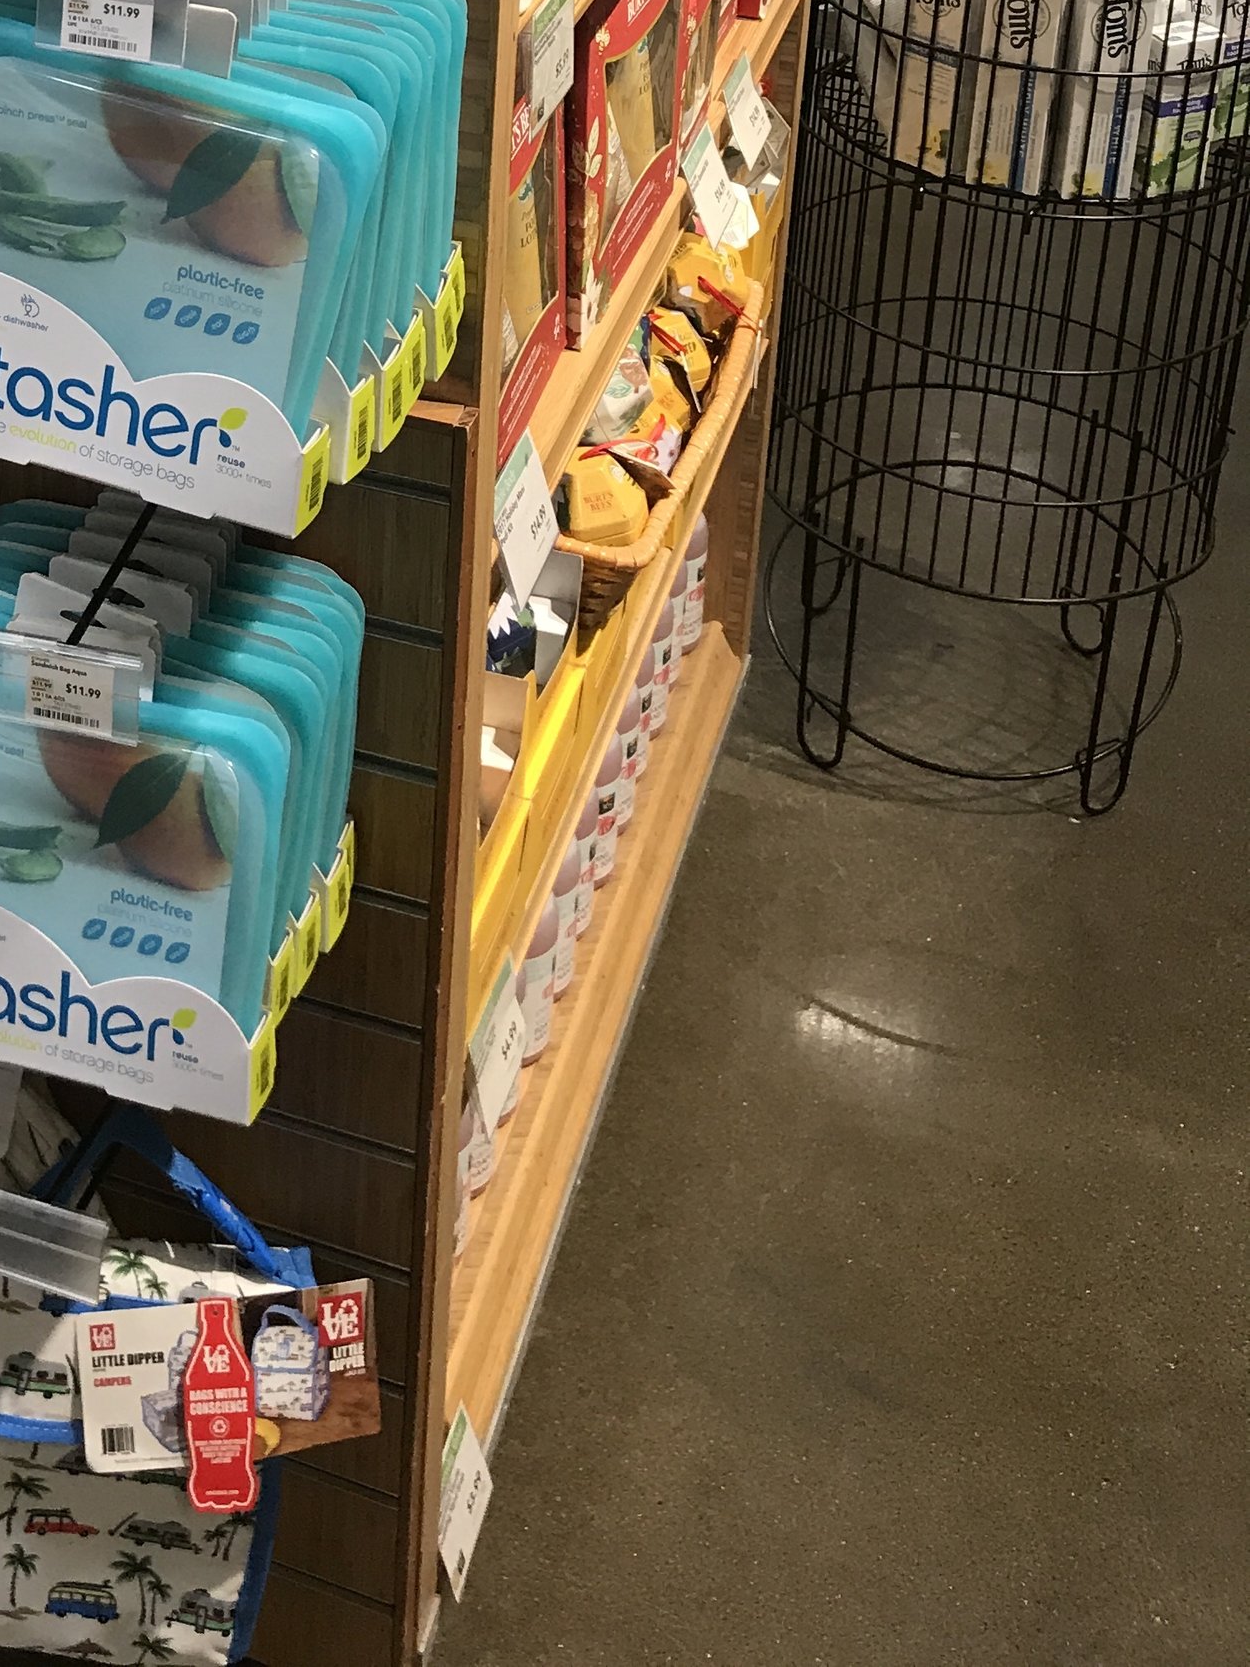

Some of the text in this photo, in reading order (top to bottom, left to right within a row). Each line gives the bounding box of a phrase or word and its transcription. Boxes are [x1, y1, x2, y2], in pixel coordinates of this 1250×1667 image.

[102, 3, 141, 21] $11.99
[177, 262, 266, 303] plastic-free
[1, 312, 51, 333] dishwasher
[9, 422, 79, 454] evolution
[79, 442, 96, 461] of
[96, 447, 154, 480] storage
[155, 460, 196, 491] bags
[216, 453, 247, 471] reuse
[65, 682, 102, 700] $11.99
[109, 887, 194, 923] plastic-free
[44, 1040, 61, 1059] of
[61, 1045, 116, 1073] storage
[116, 1057, 156, 1085] bags
[92, 1352, 165, 1368] LITTLE DIPPER
[333, 1342, 365, 1360] LITTLE
[329, 1355, 366, 1373] DIPPER
[93, 1376, 132, 1388] CAMPERS
[214, 1387, 239, 1400] WITH
[189, 1400, 249, 1415] CONSCIENCE
